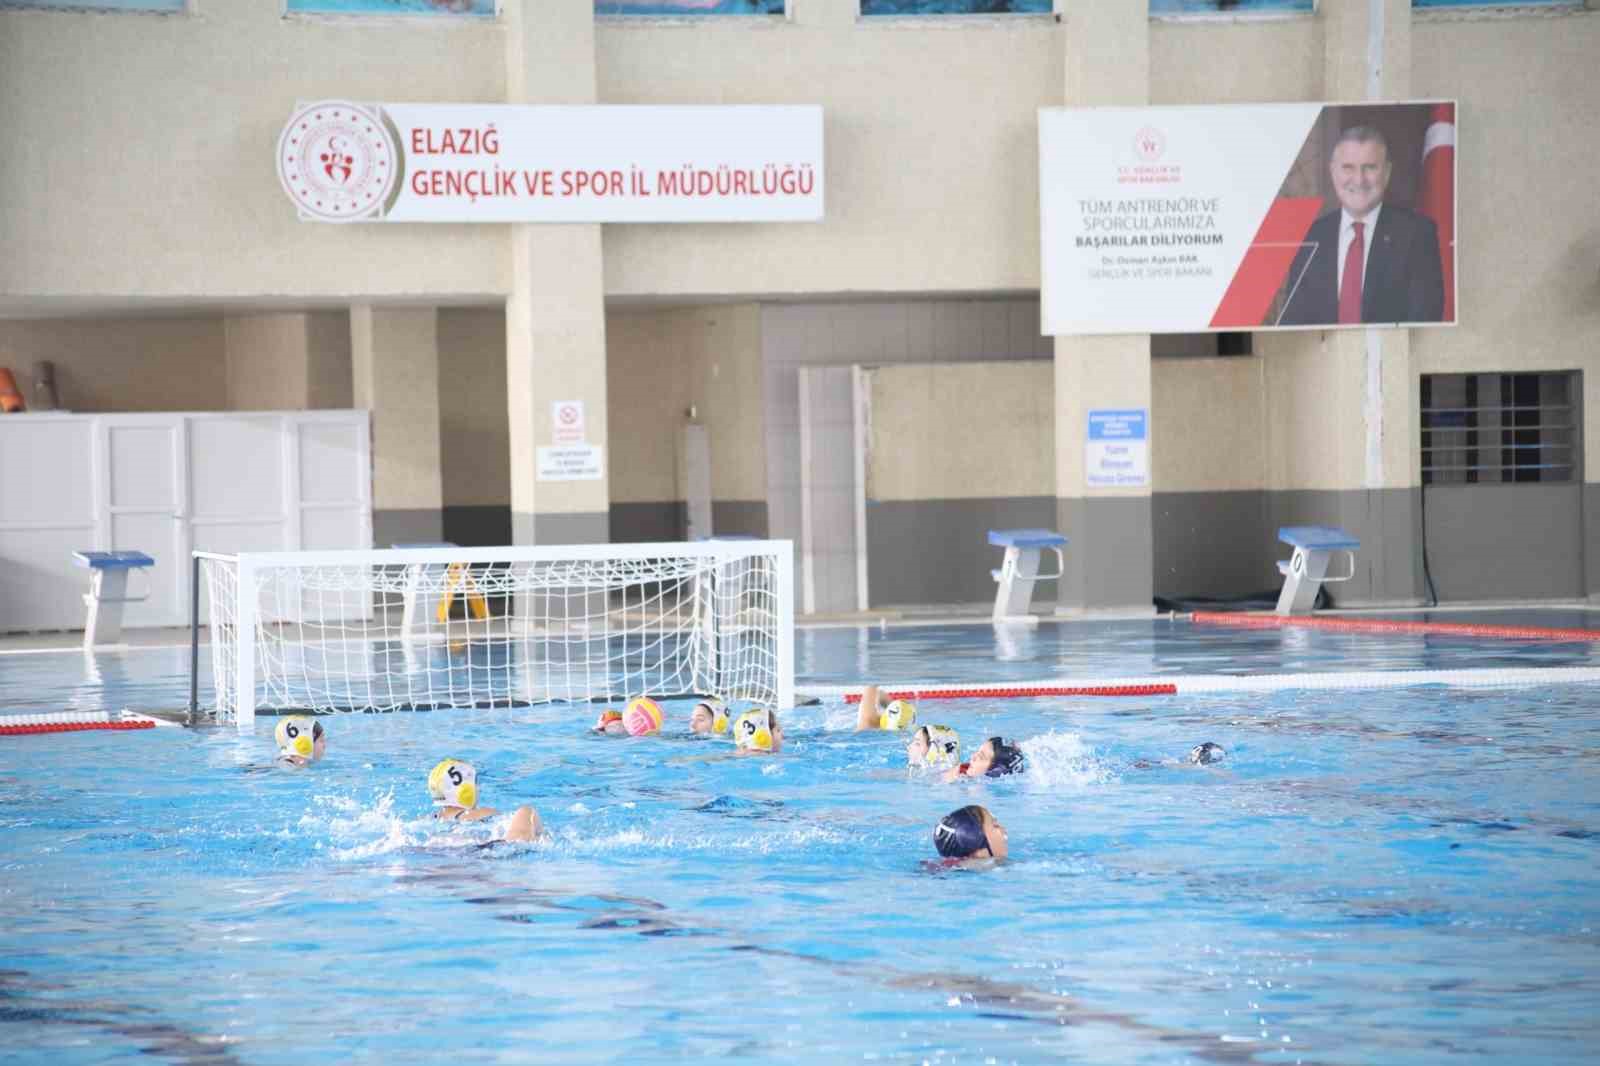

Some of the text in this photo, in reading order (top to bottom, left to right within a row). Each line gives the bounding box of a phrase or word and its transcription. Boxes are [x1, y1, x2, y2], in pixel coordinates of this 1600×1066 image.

[411, 122, 499, 155] ELAZIĞ
[411, 162, 814, 203] GENÇLİK VE SPOR İL MÜDÜRLÜĞÜ
[1079, 197, 1220, 214] TÜM ANTRENÖR VE
[1083, 214, 1216, 231] SPORCULARIMIZA
[1075, 232, 1224, 250] BAŞARILAR DİLİYORUM
[286, 721, 300, 739] 6
[743, 719, 756, 736] 3
[447, 765, 463, 787] 5
